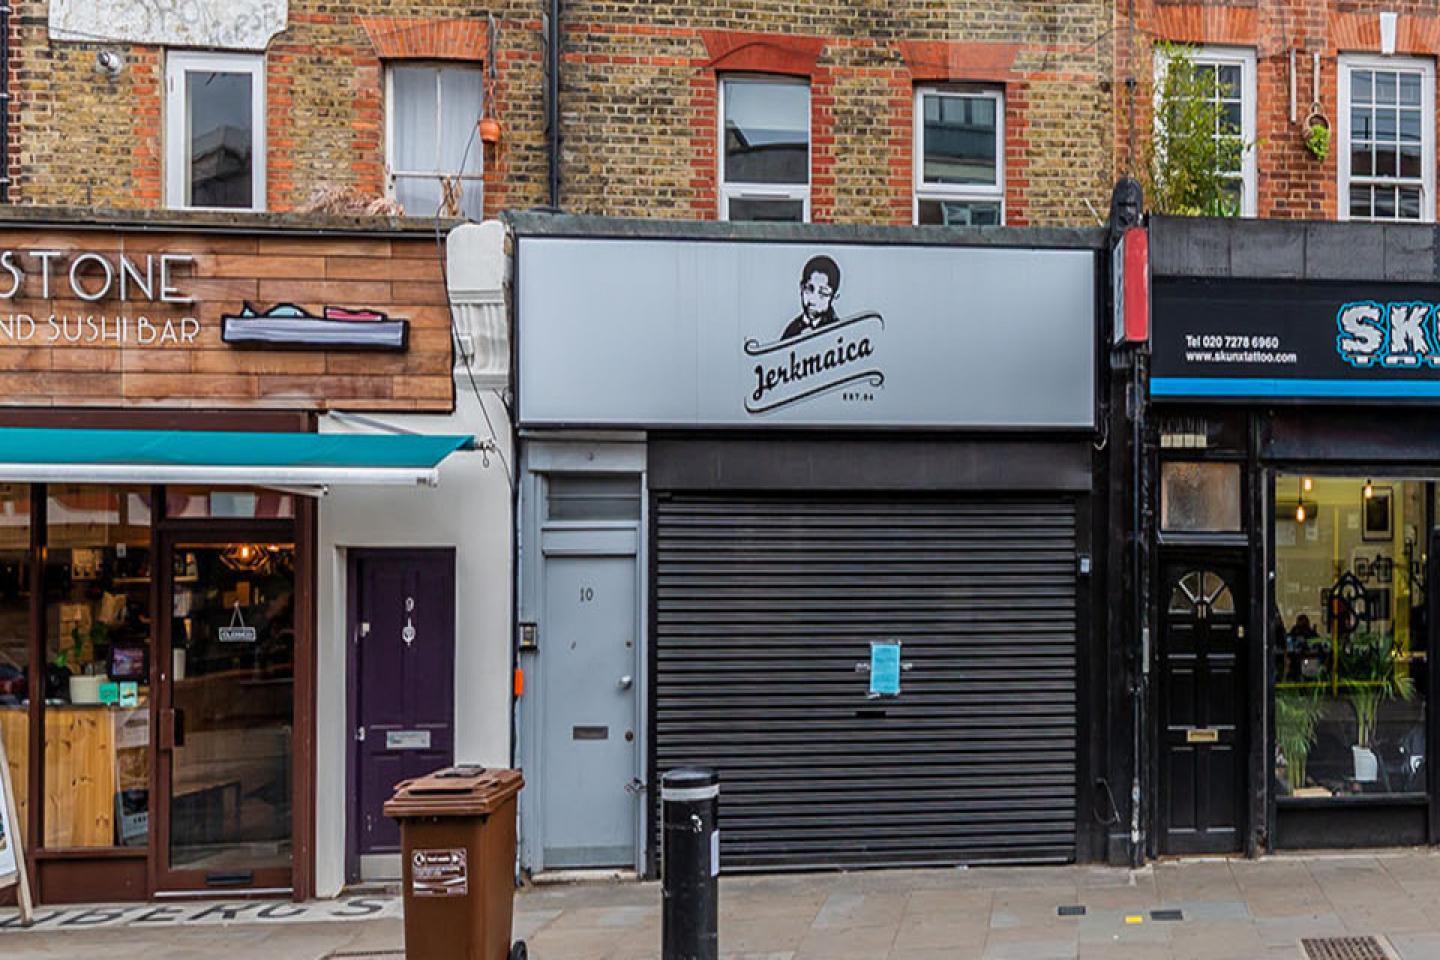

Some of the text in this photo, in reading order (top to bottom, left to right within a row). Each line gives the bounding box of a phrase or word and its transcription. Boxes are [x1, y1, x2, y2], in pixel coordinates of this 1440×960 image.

[0, 251, 194, 302] STONE
[47, 313, 127, 342] SUSHI
[137, 315, 200, 344] BAR
[1185, 335, 1280, 350] Tel 020 7278 6960
[1185, 350, 1297, 364] www.skunxtattoo.com
[752, 336, 874, 401] Jerkmaica
[580, 587, 594, 602] 10
[405, 597, 415, 612] 9
